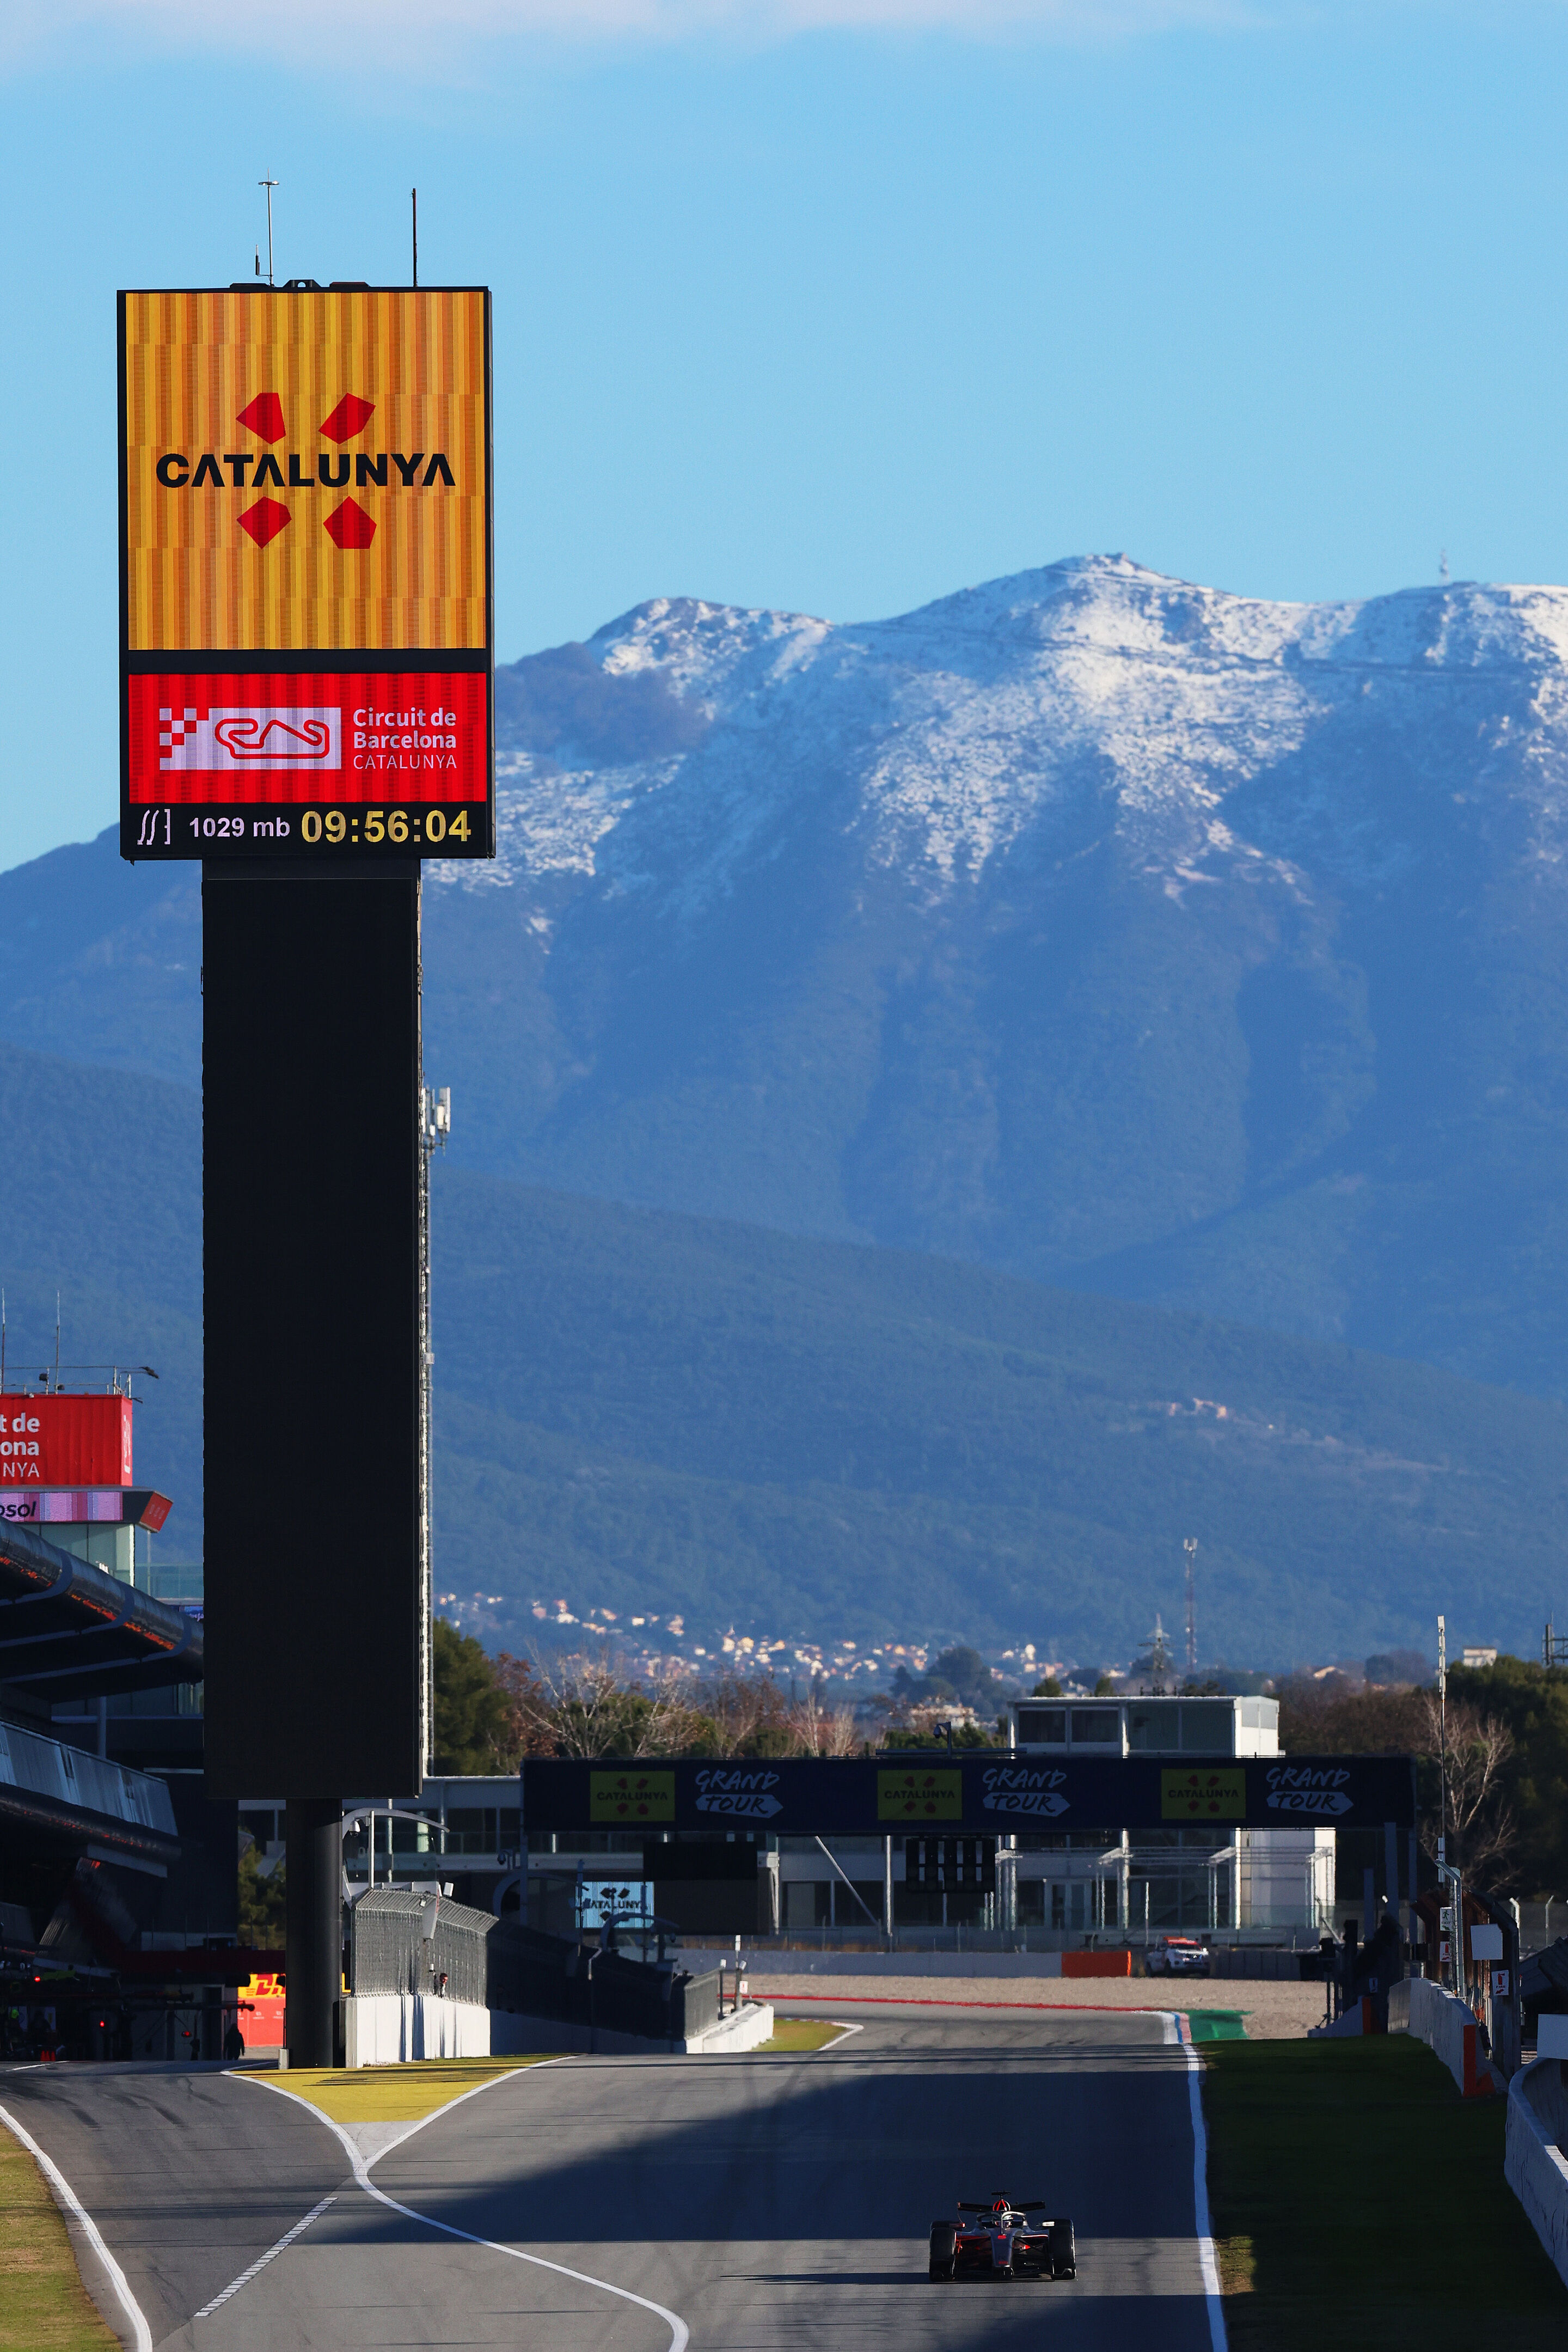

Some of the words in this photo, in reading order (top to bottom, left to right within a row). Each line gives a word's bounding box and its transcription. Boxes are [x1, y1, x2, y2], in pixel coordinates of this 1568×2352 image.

[156, 453, 456, 488] CATALUNYA
[353, 706, 426, 728] Circuit
[431, 706, 456, 727] de
[353, 730, 456, 749] Barcelona
[353, 754, 457, 770] CATALUNYA
[188, 817, 245, 837] 1029
[253, 816, 290, 837] mb
[301, 810, 471, 843] 09:56:04
[12, 1412, 40, 1433] de
[0, 1440, 40, 1456] ona
[3, 1461, 40, 1478] NYA
[695, 1769, 780, 1793] GRAND
[982, 1768, 1068, 1791] GRAND
[1265, 1766, 1351, 1790] GRAND
[596, 1791, 668, 1801] CATALUNYA
[884, 1790, 955, 1800] CATALUNYA
[993, 1793, 1056, 1813] TOUR
[1168, 1789, 1239, 1799] CATALUNYA
[1276, 1793, 1339, 1812] TOUR
[705, 1795, 769, 1815] TOUR
